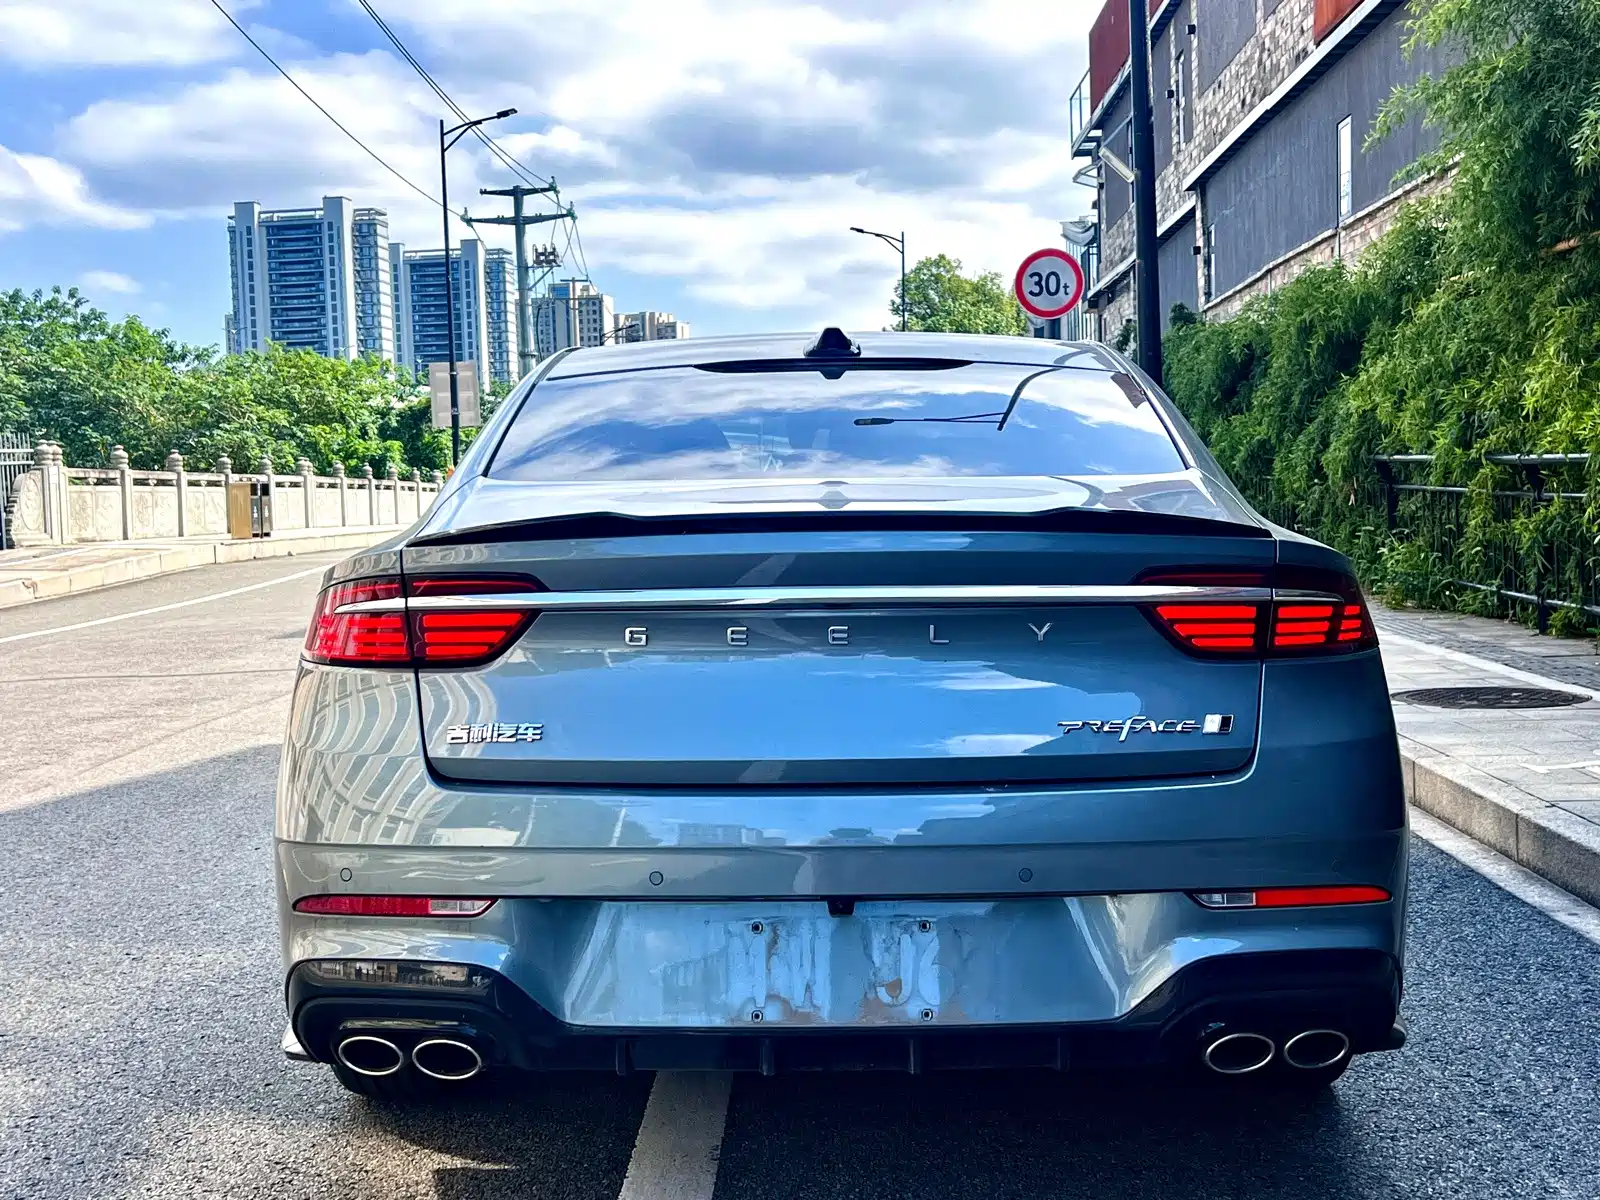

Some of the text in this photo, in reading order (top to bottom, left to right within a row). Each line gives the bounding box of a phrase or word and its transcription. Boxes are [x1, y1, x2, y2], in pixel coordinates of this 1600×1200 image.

[623, 622, 1053, 647] GEELY
[446, 722, 544, 743] 吉利汽车
[1057, 715, 1200, 742] PREFACE
